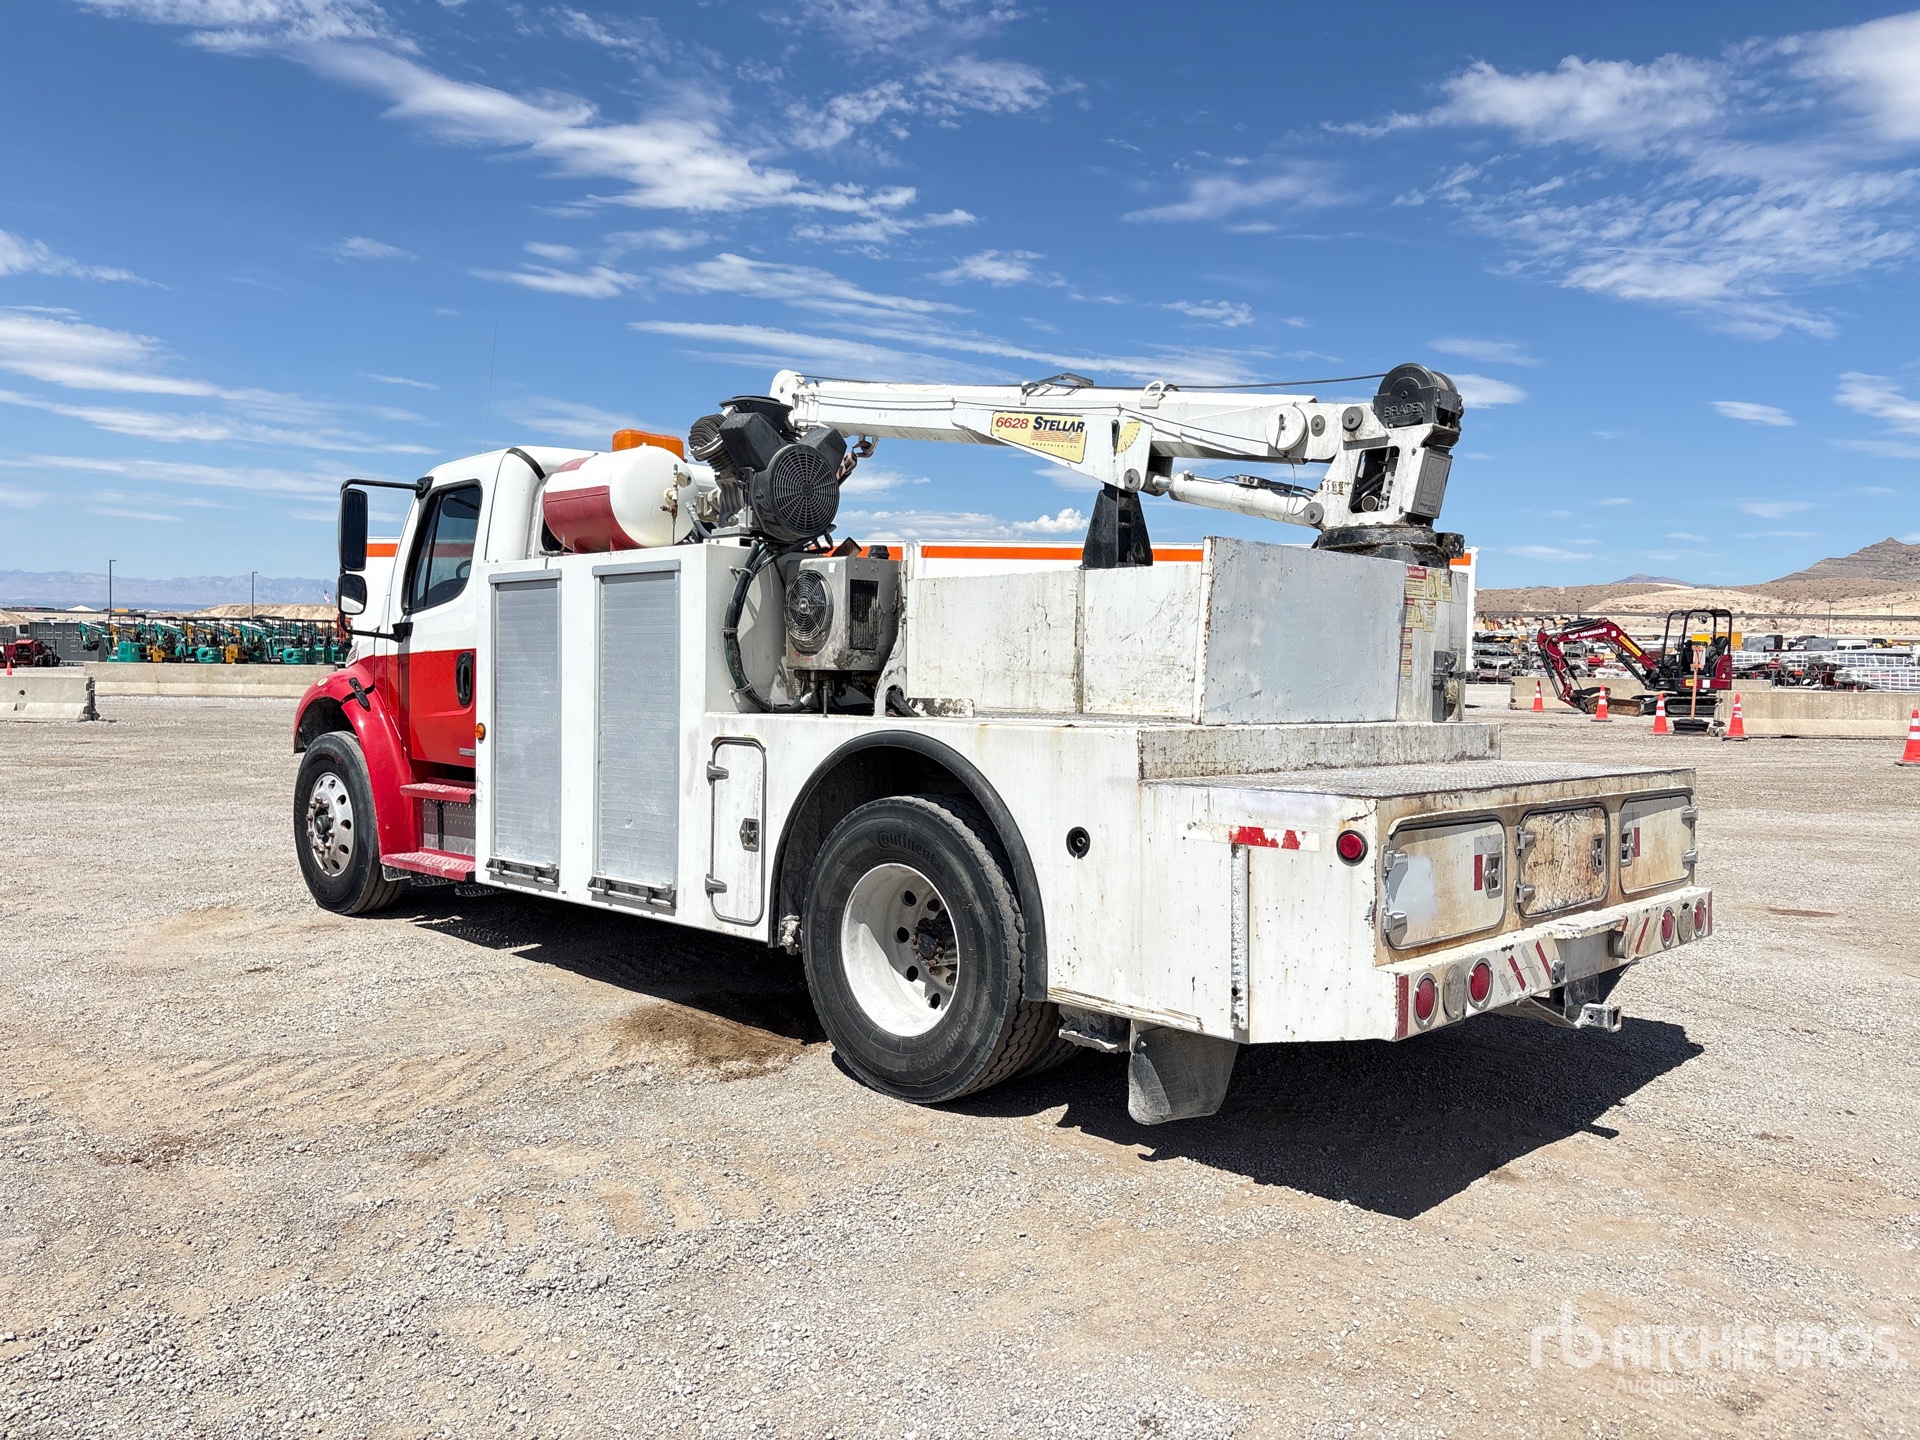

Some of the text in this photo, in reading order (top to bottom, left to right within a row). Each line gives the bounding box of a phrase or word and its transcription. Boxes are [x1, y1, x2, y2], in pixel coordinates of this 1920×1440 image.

[1383, 401, 1426, 419] BRADEN
[995, 416, 1085, 432] 6628 STELLAR
[1579, 628, 1607, 637] YANMAR
[877, 831, 944, 872] Continental
